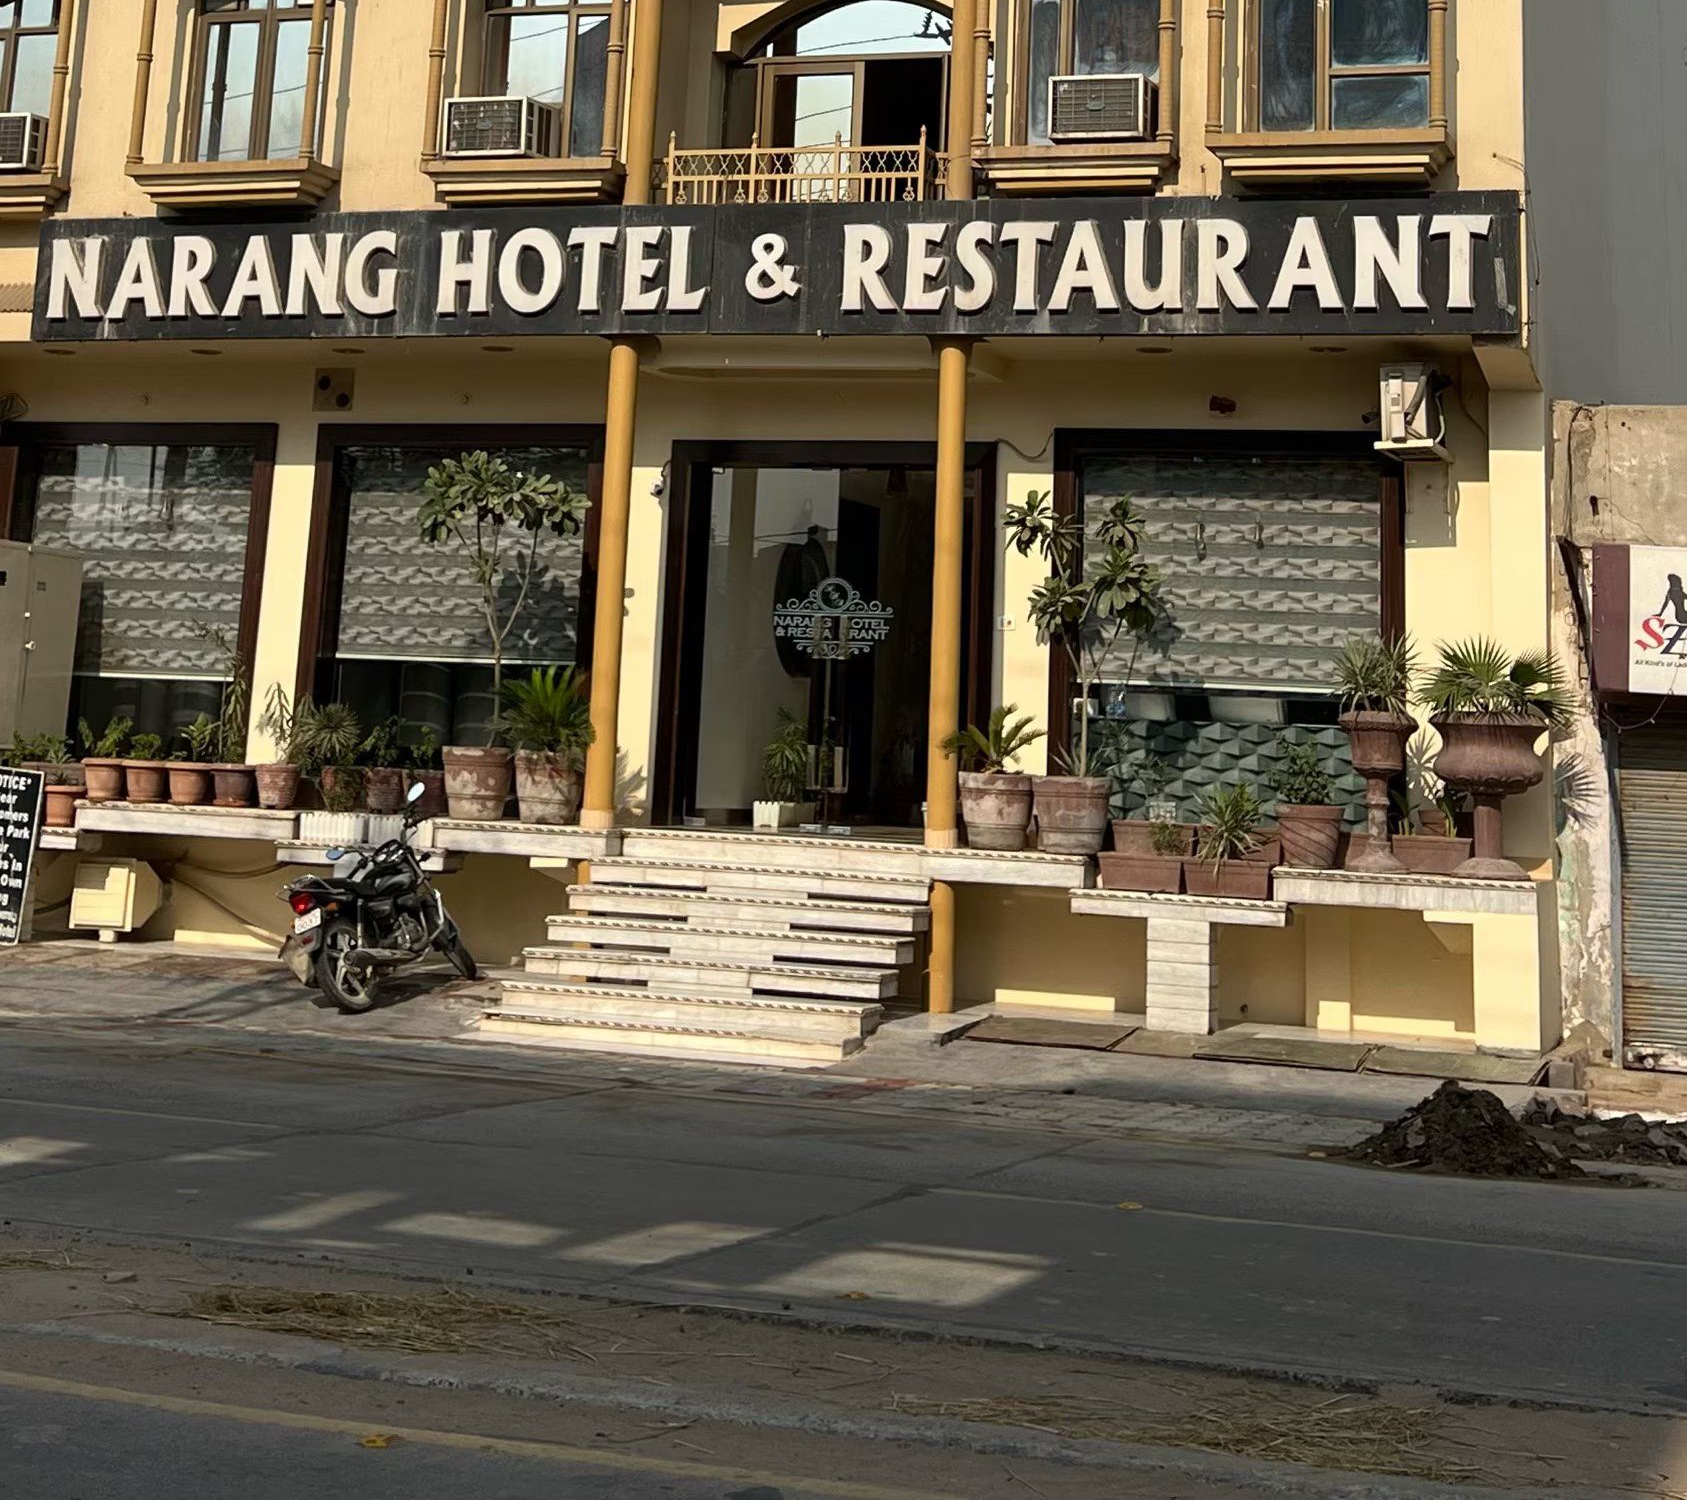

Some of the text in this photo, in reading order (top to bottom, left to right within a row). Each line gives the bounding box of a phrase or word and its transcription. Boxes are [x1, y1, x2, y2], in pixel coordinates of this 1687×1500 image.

[45, 213, 1492, 320] NARANG HOTEL & RESTAURANT
[842, 617, 890, 630] OTEL
[775, 626, 889, 640] & RESARANT
[0, 793, 18, 804] ear
[0, 809, 29, 823] omers
[6, 824, 30, 839] Park
